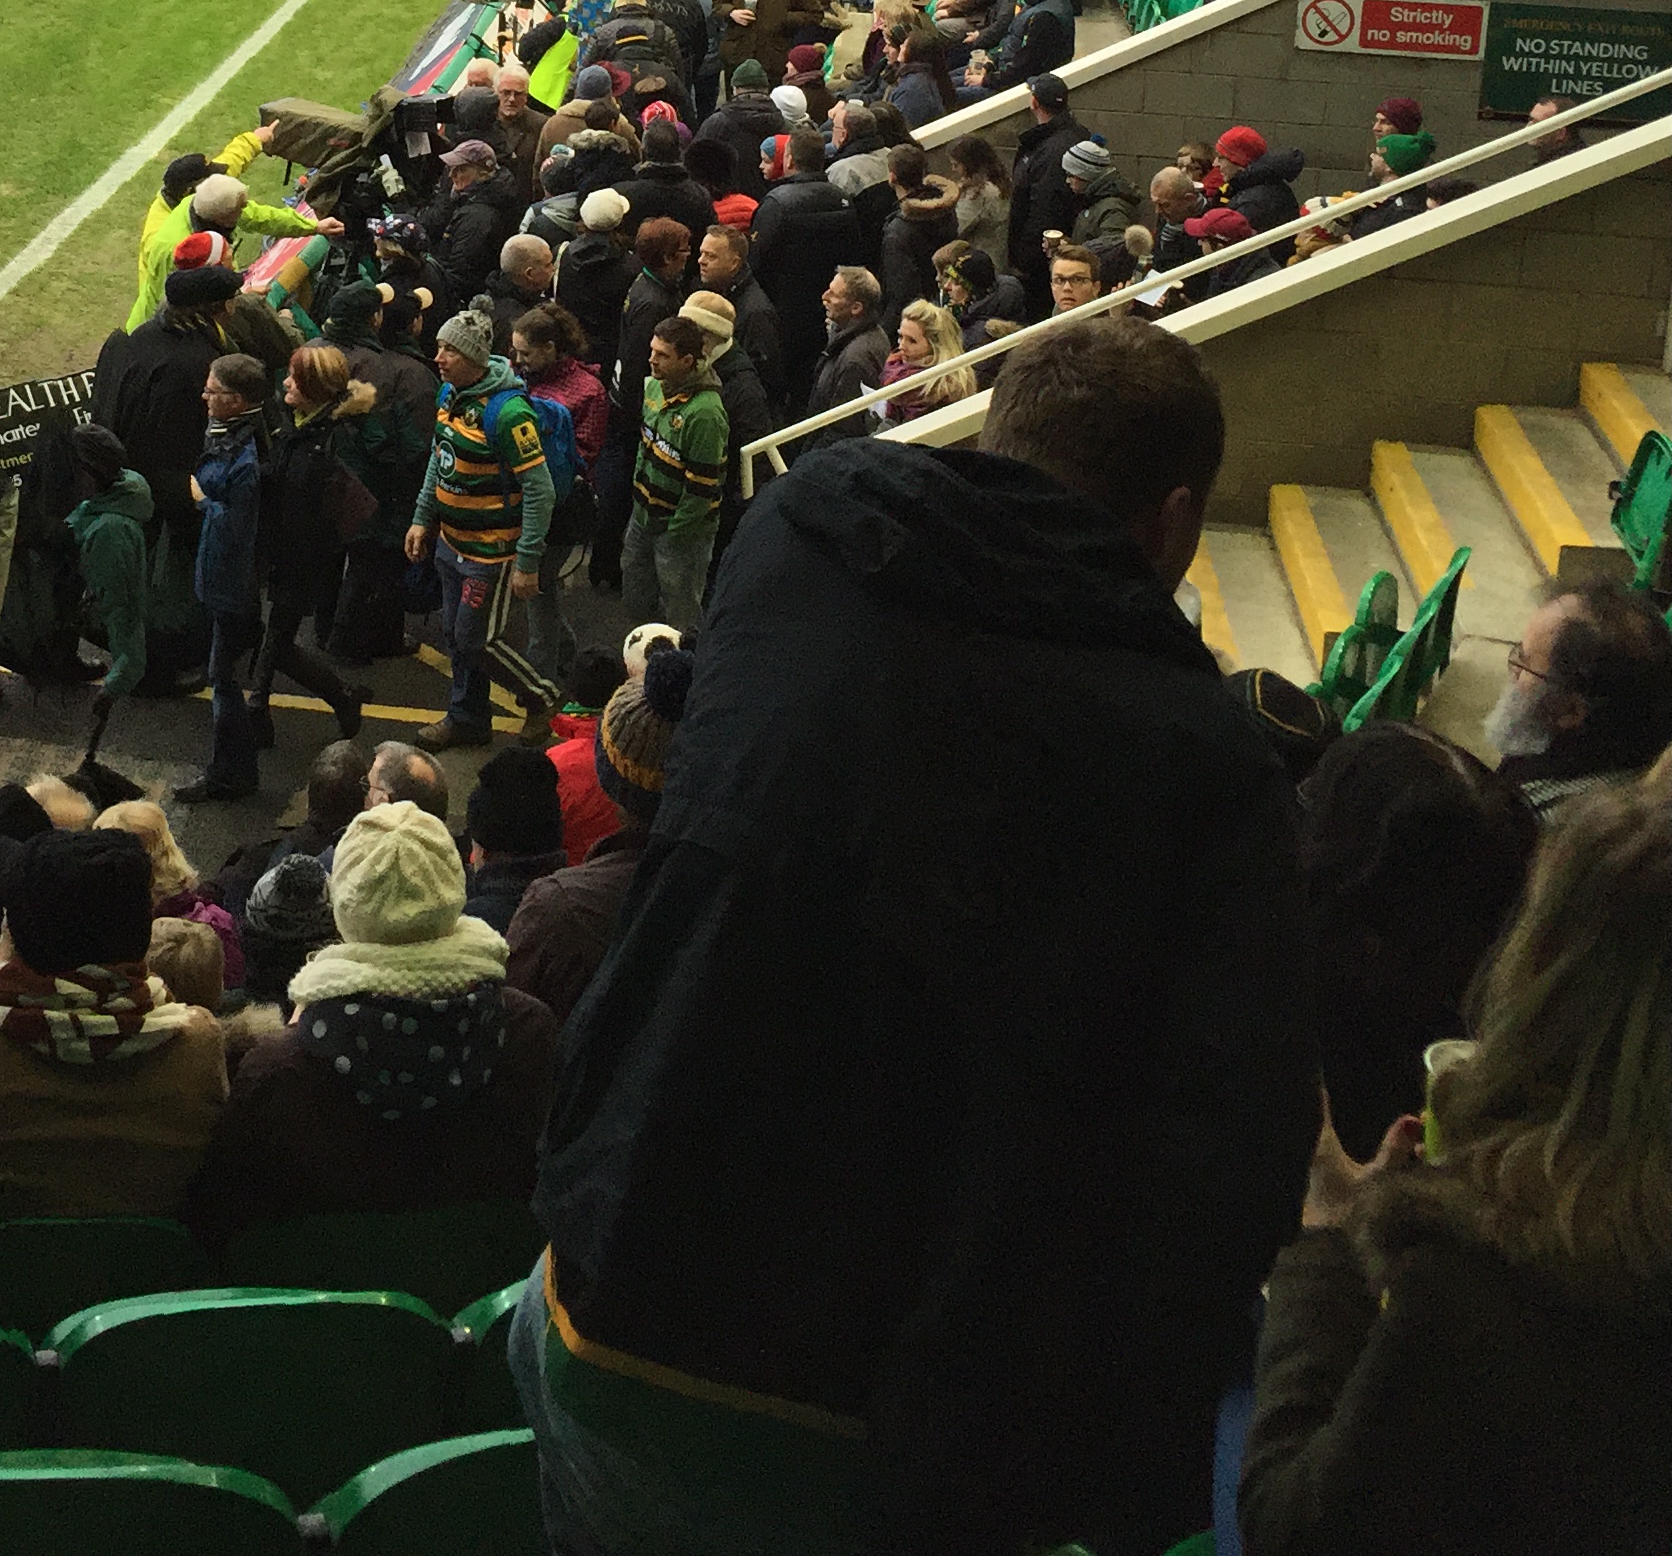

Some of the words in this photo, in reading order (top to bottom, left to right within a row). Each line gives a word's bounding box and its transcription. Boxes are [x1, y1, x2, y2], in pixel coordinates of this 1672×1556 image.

[1390, 6, 1453, 29] Strictly
[1367, 29, 1391, 42] no
[1396, 30, 1473, 51] smoking
[1515, 37, 1546, 54] NO
[1549, 39, 1649, 60] STANDING
[1502, 56, 1575, 75] WITHIN
[1580, 60, 1659, 79] YELLOW
[1550, 78, 1604, 95] LINES
